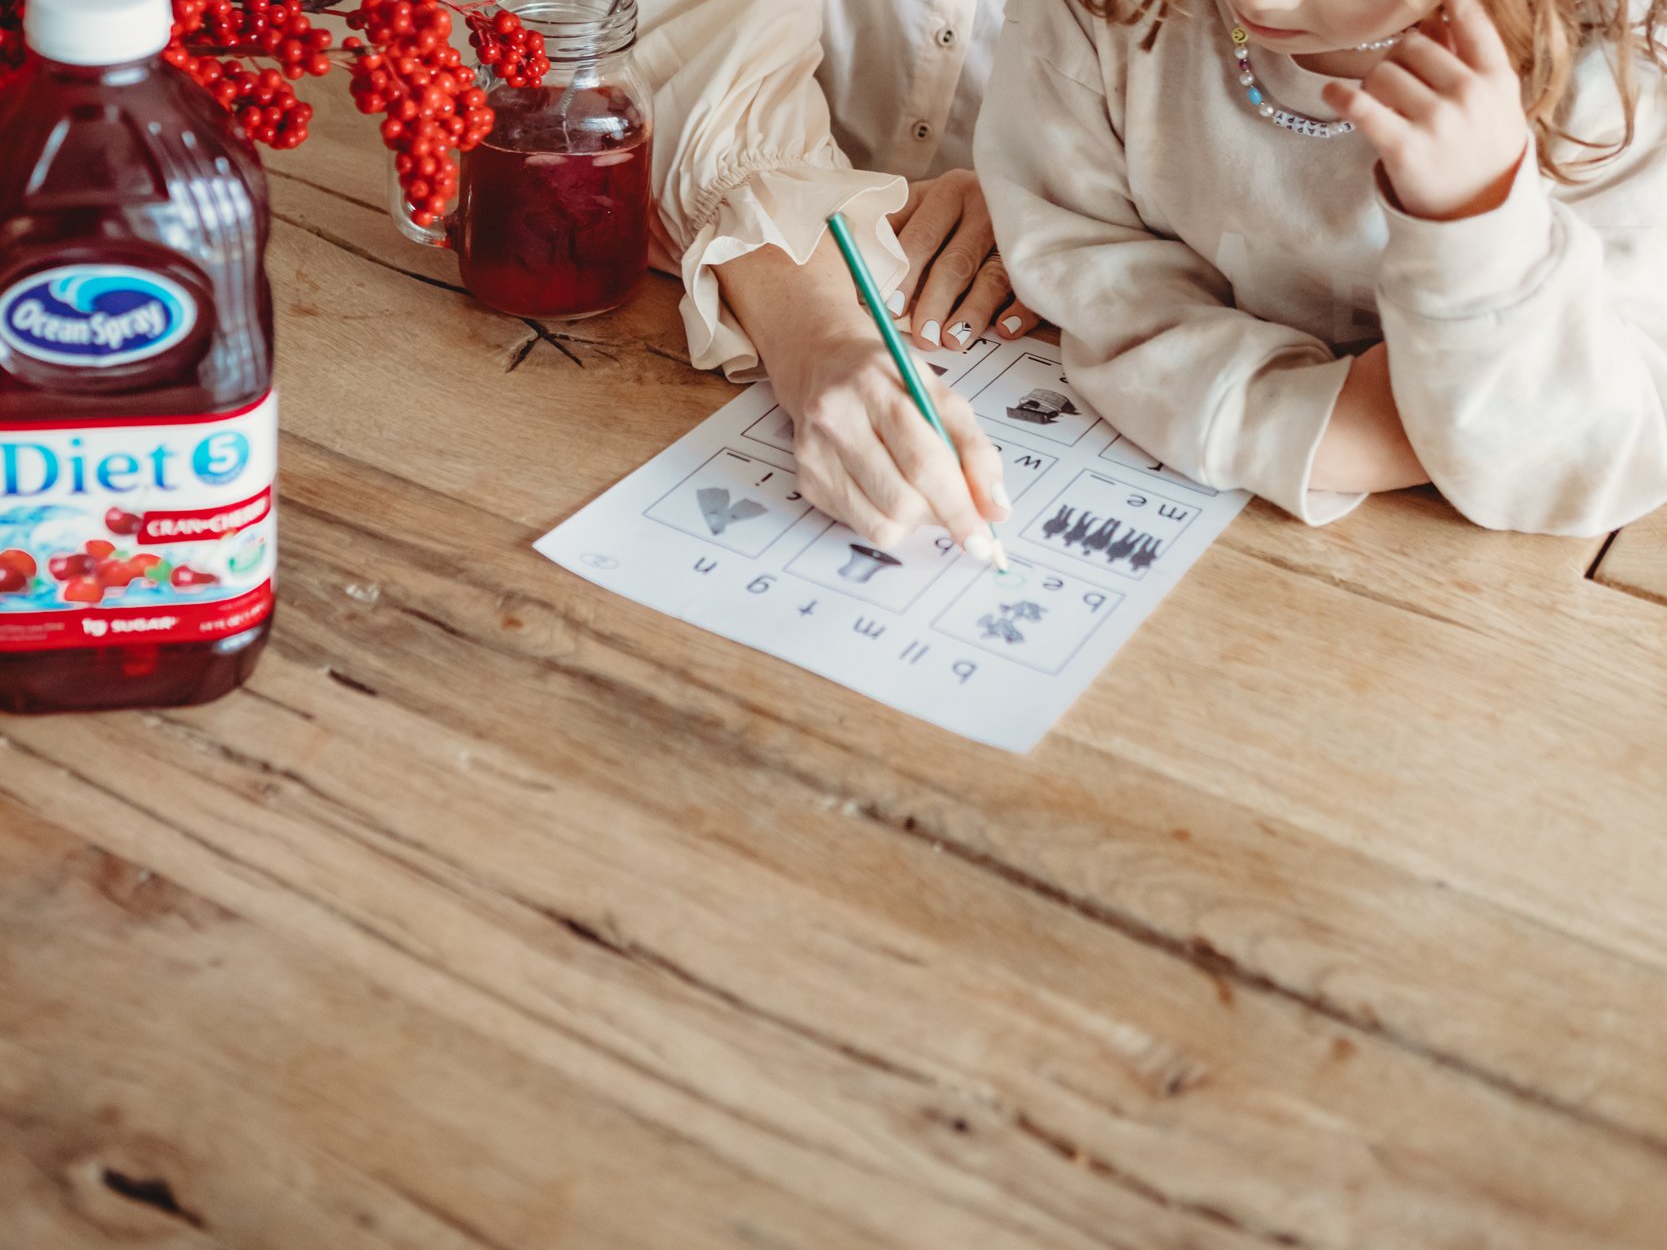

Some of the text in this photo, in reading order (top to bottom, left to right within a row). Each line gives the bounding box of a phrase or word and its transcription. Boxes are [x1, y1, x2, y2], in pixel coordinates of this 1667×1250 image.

[12, 298, 166, 350] Ocean Spray
[0, 434, 239, 494] Diet 5
[1014, 454, 1042, 470] w
[754, 472, 774, 487] i
[1126, 494, 1188, 523] m e
[934, 536, 955, 556] b
[693, 556, 717, 575] n
[745, 574, 778, 595] g
[1042, 577, 1064, 590] e
[798, 599, 818, 617] t
[1082, 592, 1107, 613] b
[111, 616, 176, 633] SUGAR
[853, 616, 886, 640] m
[951, 661, 978, 685] b
